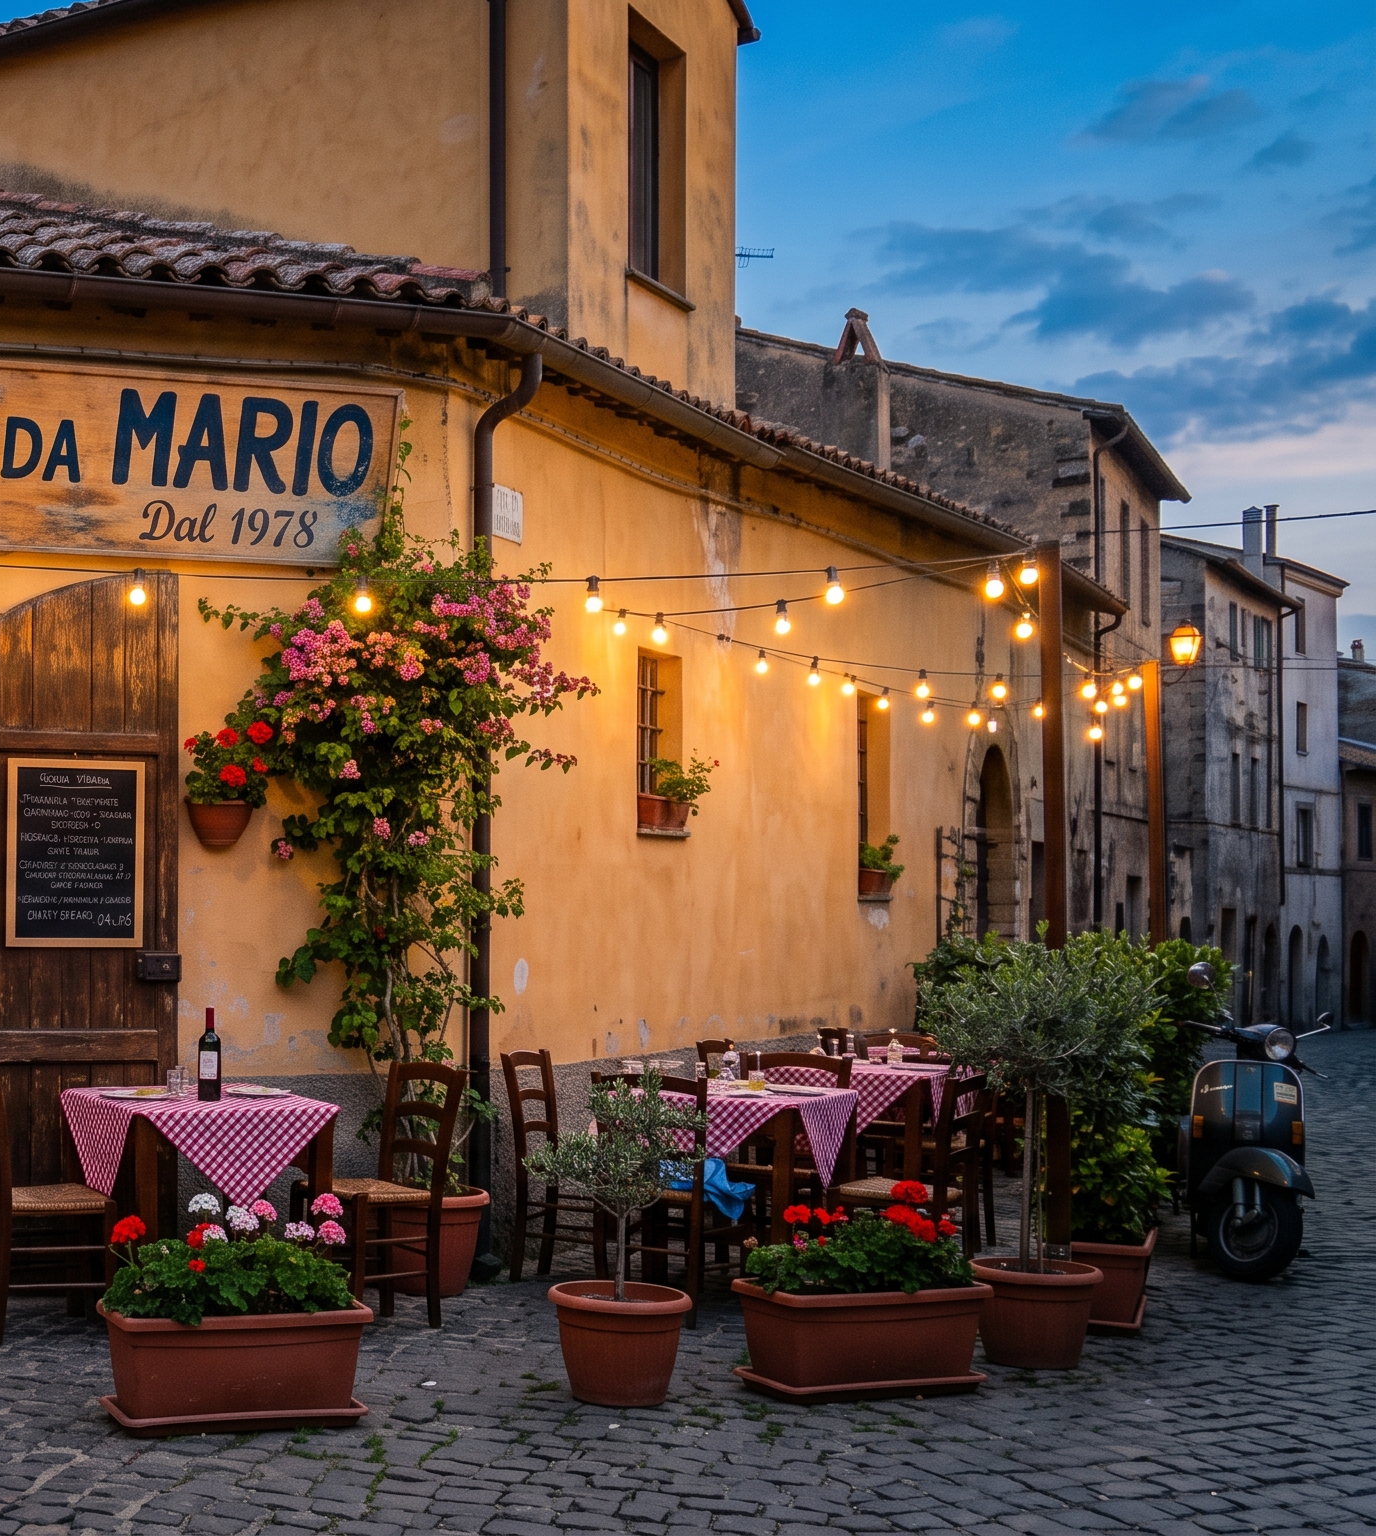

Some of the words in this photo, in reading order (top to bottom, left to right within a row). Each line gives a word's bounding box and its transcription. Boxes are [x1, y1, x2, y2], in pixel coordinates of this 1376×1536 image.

[1, 416, 81, 483] DA
[112, 388, 374, 498] MARIO
[139, 499, 219, 544] Dal
[231, 507, 318, 548] 1978
